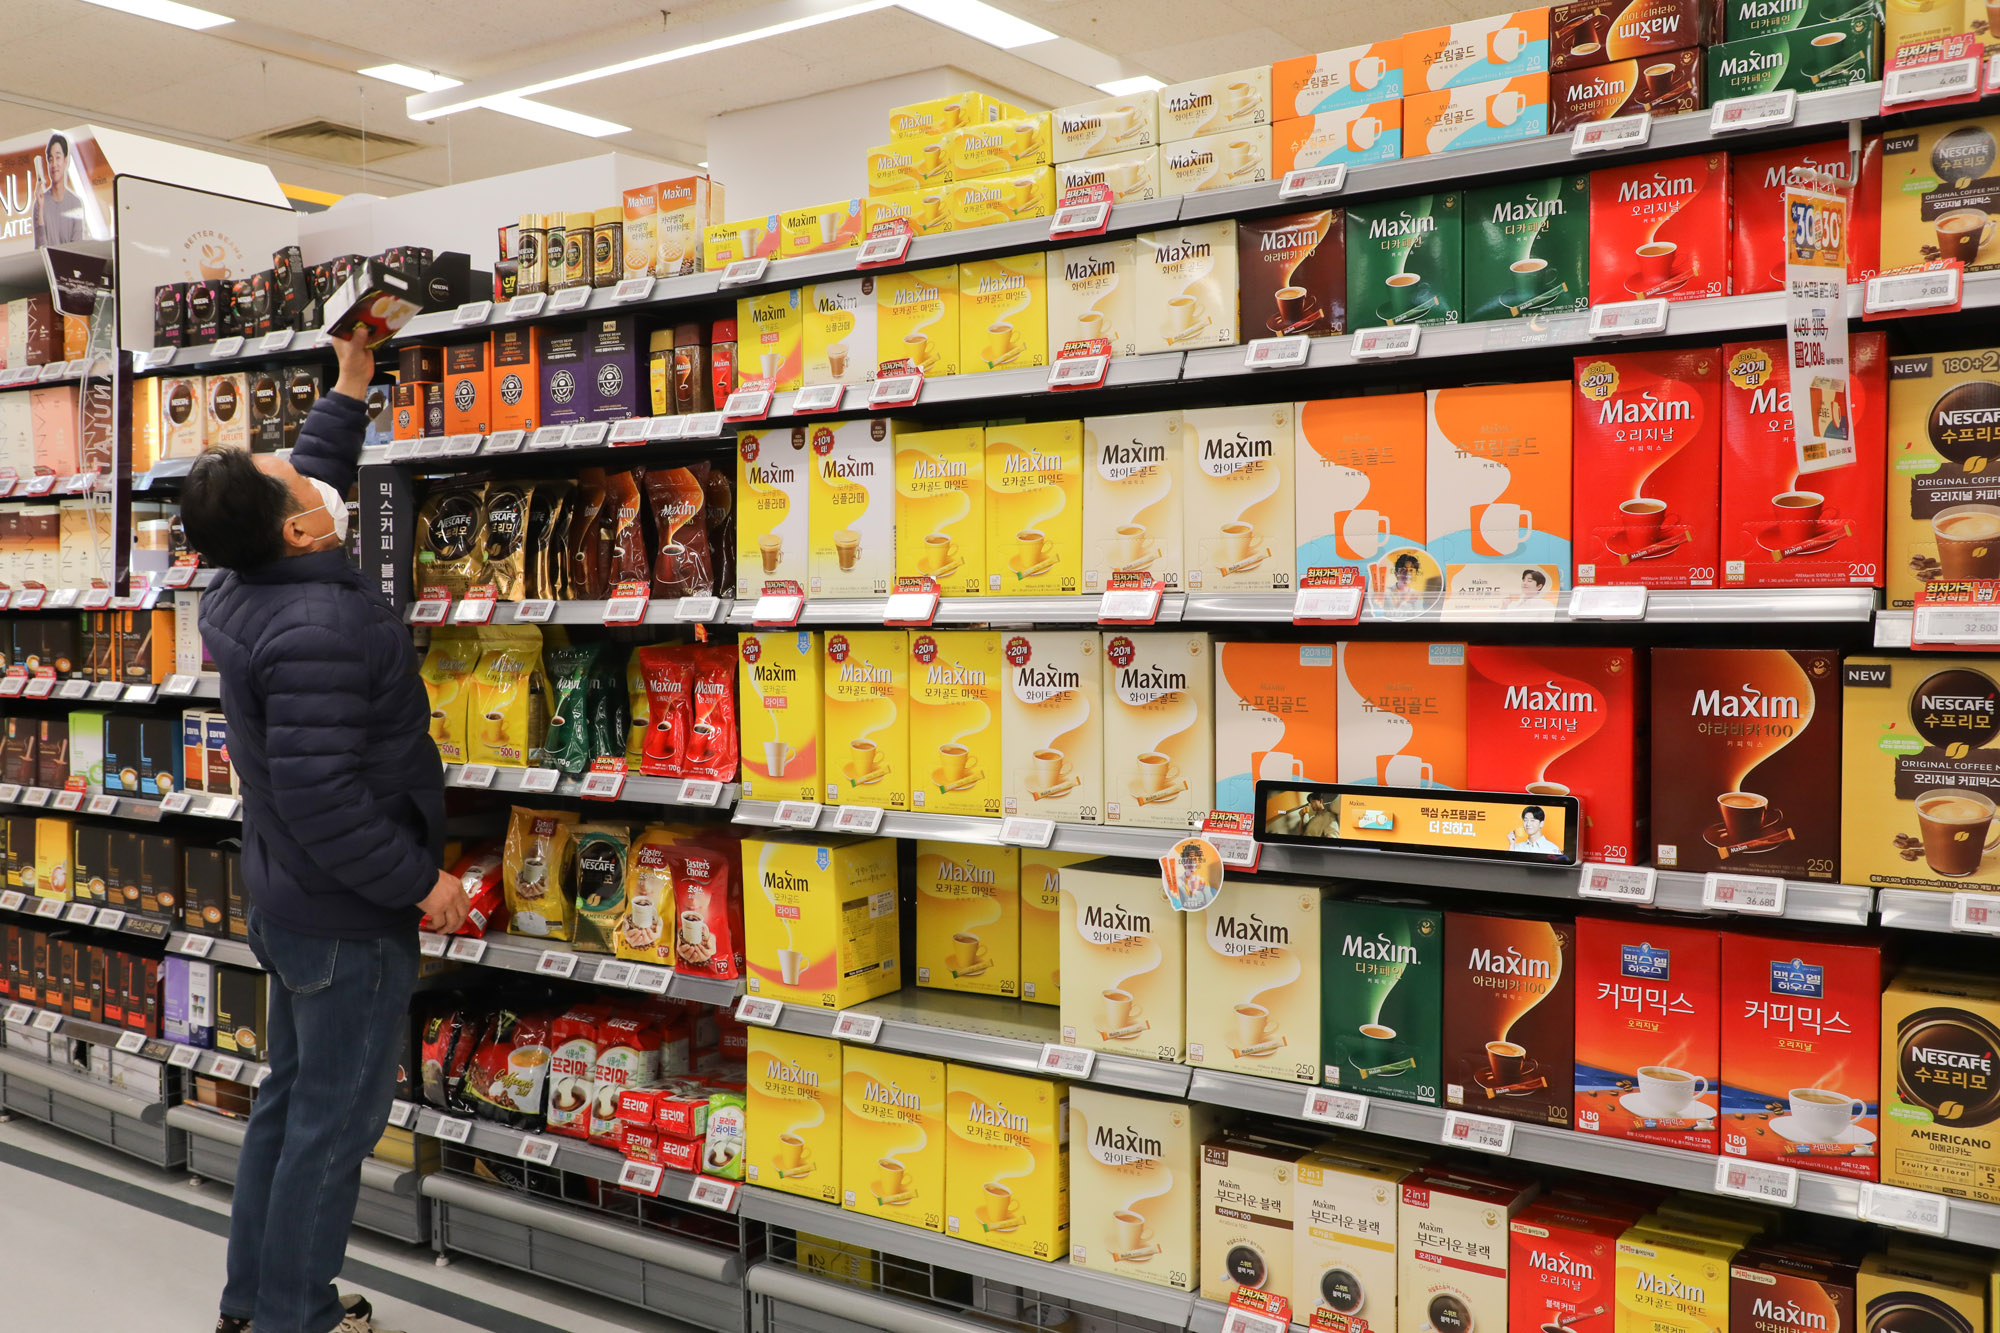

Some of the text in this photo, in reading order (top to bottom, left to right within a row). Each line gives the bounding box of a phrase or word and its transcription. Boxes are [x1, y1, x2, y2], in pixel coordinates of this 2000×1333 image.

[1739, 0, 1804, 21] Maxim
[1439, 39, 1458, 48] Maxim
[1422, 45, 1475, 66] 슈프림골드
[1731, 72, 1771, 87] 디카페인
[1169, 92, 1213, 114] Maxim
[1678, 98, 1693, 109] 20
[1253, 109, 1264, 119] 20
[899, 113, 933, 130] Maxim
[1886, 139, 1914, 150] NEW
[964, 151, 986, 160] 모카골드
[1941, 156, 1986, 170] 수프리모
[944, 170, 953, 180] 20
[662, 185, 691, 201] Maxim
[1618, 172, 1693, 203] Maxim
[1926, 192, 1958, 200] ORIGINAL
[1960, 188, 1986, 196] COFFEE
[1631, 201, 1681, 217] 오리지날
[1933, 197, 1991, 210] 오리지널 커피믹스
[1369, 211, 1434, 241] Maxim
[1505, 220, 1549, 236] 디카페인
[1795, 205, 1814, 245] 30
[183, 230, 214, 249] BETTER
[1381, 237, 1423, 250] 디카페인
[1065, 257, 1115, 280] Maxim
[1860, 270, 1876, 281] 50
[894, 284, 939, 304] Maxim
[1446, 310, 1458, 321] 50
[761, 333, 779, 343] 라이트
[866, 371, 875, 380] 50
[1894, 363, 1928, 374] NEW
[1583, 373, 1613, 388] +20개
[1596, 386, 1607, 397] 더!
[1599, 391, 1691, 424] Maxim
[1614, 428, 1674, 443] 오리지날
[1204, 432, 1272, 461] Maxim
[1455, 436, 1540, 459] 슈프림골드
[1004, 448, 1061, 473] Maxim
[1320, 447, 1396, 468] 슈프림골드
[750, 462, 794, 484] Maxim
[911, 478, 969, 492] 모카골드 마일드
[832, 491, 865, 504] 심플라떼
[1272, 572, 1289, 584] 100
[1688, 567, 1714, 579] 200
[873, 579, 886, 589] 110
[965, 578, 979, 588] 100
[1926, 582, 1971, 593] 최저가격
[1109, 646, 1131, 657] +20개
[927, 661, 985, 685] Maxim
[1121, 664, 1186, 689] Maxim
[1849, 670, 1885, 681] NEW
[650, 680, 682, 693] Maxim
[1504, 680, 1592, 712] Maxim
[1238, 695, 1310, 713] 슈프림골드
[1520, 717, 1578, 733] 오리지날
[1923, 714, 1991, 729] 수프리모
[501, 747, 521, 758] 500 g
[1902, 759, 1992, 771] ORIGINAL COFFEE
[1914, 773, 1955, 785] 오리지널
[801, 788, 815, 797] 200
[984, 798, 1000, 808] 200
[1187, 811, 1205, 821] 200
[1421, 807, 1486, 821] 맥심 슈프림골드
[1429, 821, 1476, 837] 더 진하고,
[1731, 845, 1748, 853] Maxim
[640, 855, 662, 864] Choice
[684, 859, 709, 869] Taster's
[1807, 858, 1834, 872] 250
[686, 868, 709, 878] Choice
[938, 860, 995, 884] Maxim
[764, 869, 809, 892] Maxim
[936, 884, 998, 897] 모카골드 마일드
[777, 906, 799, 917] 라이트
[1085, 904, 1150, 933] Maxim
[1342, 932, 1418, 964] Maxim
[717, 962, 728, 971] 170
[1623, 953, 1667, 968] 맥스웰
[1355, 962, 1403, 979] 디카페인
[1628, 965, 1661, 975] 하우스
[1773, 970, 1821, 985] 맥스웰
[1778, 981, 1816, 992] 하우스
[1597, 982, 1695, 1016] 커피믹스
[1744, 1000, 1852, 1035] 커피믹스
[1778, 1039, 1812, 1052] 오리지날
[552, 1057, 587, 1076] 프리마
[767, 1060, 818, 1086] Maxim
[1296, 1064, 1314, 1075] 250
[596, 1065, 628, 1084] 프리마
[1914, 1067, 1988, 1090] 수프리모
[1417, 1086, 1435, 1097] 100
[622, 1097, 648, 1113] 프리마
[719, 1115, 736, 1126] 프리마
[1581, 1110, 1599, 1122] 180
[716, 1125, 737, 1136] 라이트
[966, 1125, 1031, 1147] 모카골드 마일드
[1095, 1125, 1161, 1156] Maxim
[1727, 1133, 1746, 1146] 180
[1912, 1129, 1991, 1150] AMERICANO
[662, 1141, 690, 1157] 프리마
[1930, 1142, 1972, 1157] 아메리카노
[1902, 1158, 1970, 1177] Fruity & Floral
[822, 1185, 836, 1195] 250
[1973, 1189, 1989, 1200] 150
[1215, 1188, 1282, 1212] 부드러운 블랙
[1218, 1207, 1251, 1221] 아라비카 100
[1419, 1221, 1442, 1234] Maxim
[1415, 1231, 1490, 1260] 부드러운 블랙
[1237, 1266, 1255, 1276] 블랙 커피
[1239, 1260, 1253, 1268] 스위트
[1540, 1274, 1582, 1292] 오리지날
[1545, 1299, 1577, 1313] 블랙커피
[1634, 1293, 1707, 1317] 모카골드 마일드
[1318, 1308, 1346, 1323] 최저가격
[1752, 1298, 1827, 1329] Maxim
